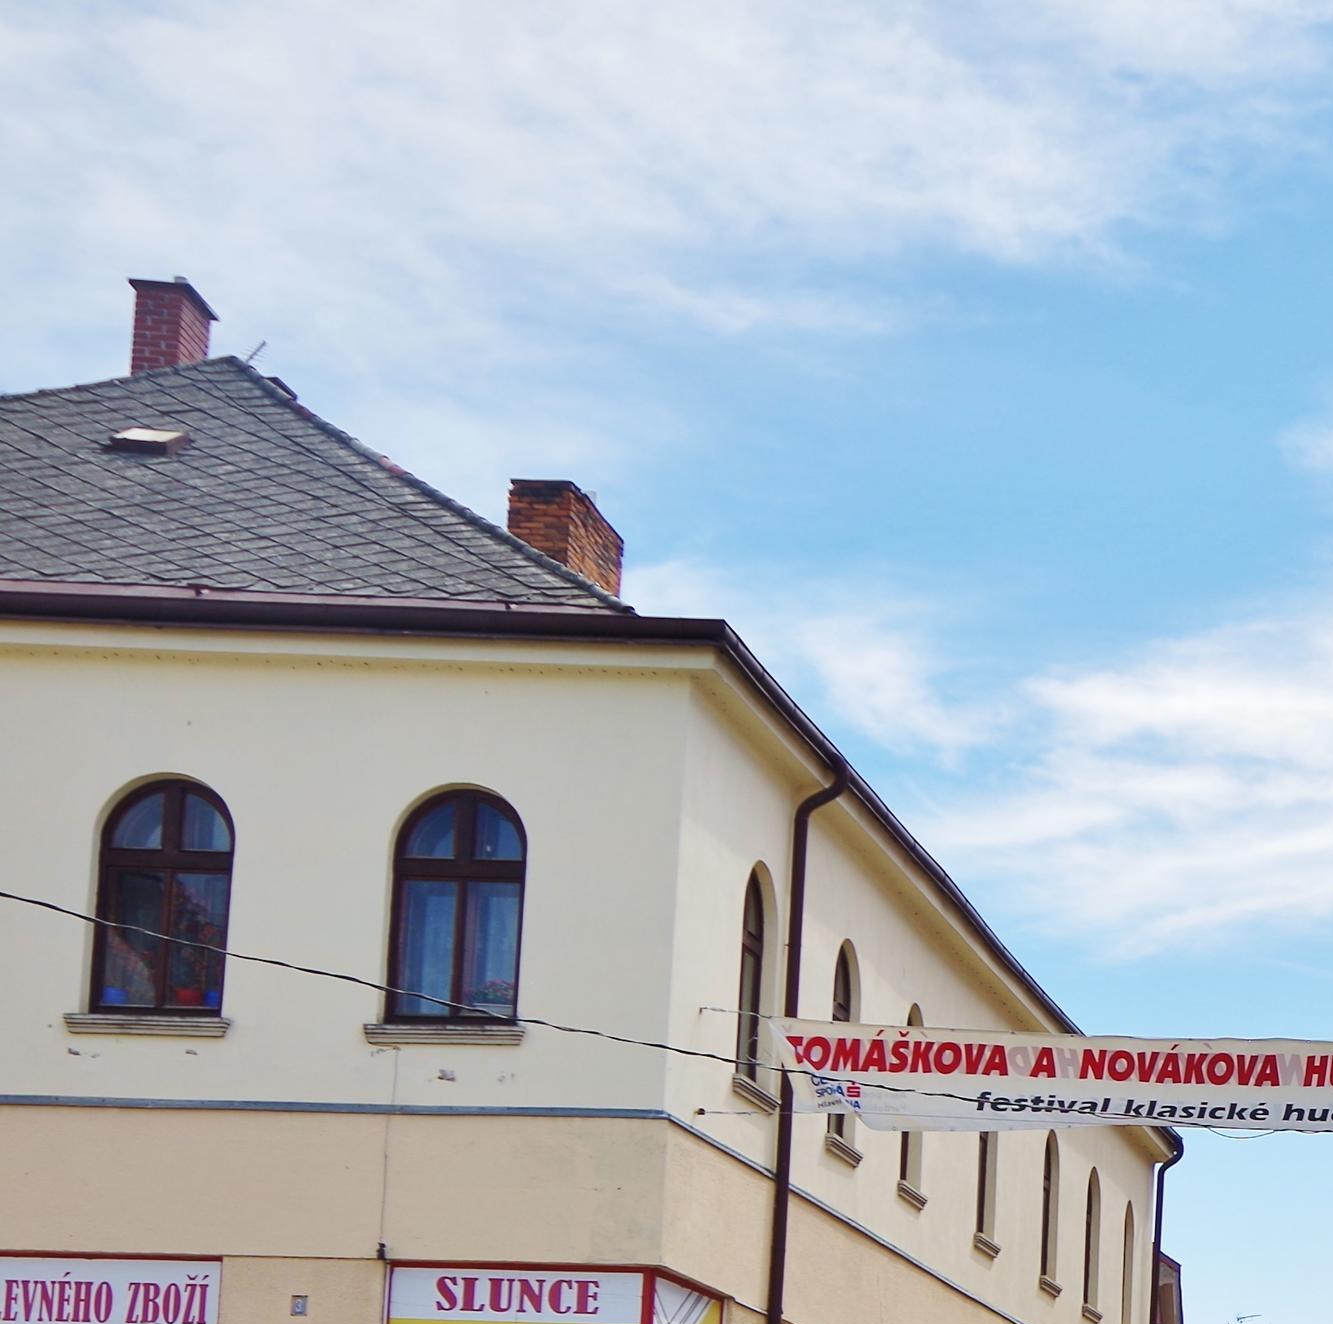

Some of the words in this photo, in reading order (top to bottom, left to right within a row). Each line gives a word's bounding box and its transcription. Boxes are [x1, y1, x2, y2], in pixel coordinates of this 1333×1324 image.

[786, 1029, 1009, 1077] TOMÁŠKOVA
[1029, 1047, 1056, 1079] A
[1078, 1044, 1280, 1087] NOVÁKOVA
[976, 1091, 1112, 1113] festival
[1123, 1100, 1270, 1121] klasické
[0, 1271, 113, 1324] EVNÉHO
[125, 1274, 209, 1324] ZBOŽÍ
[436, 1275, 600, 1315] SLUNCE
